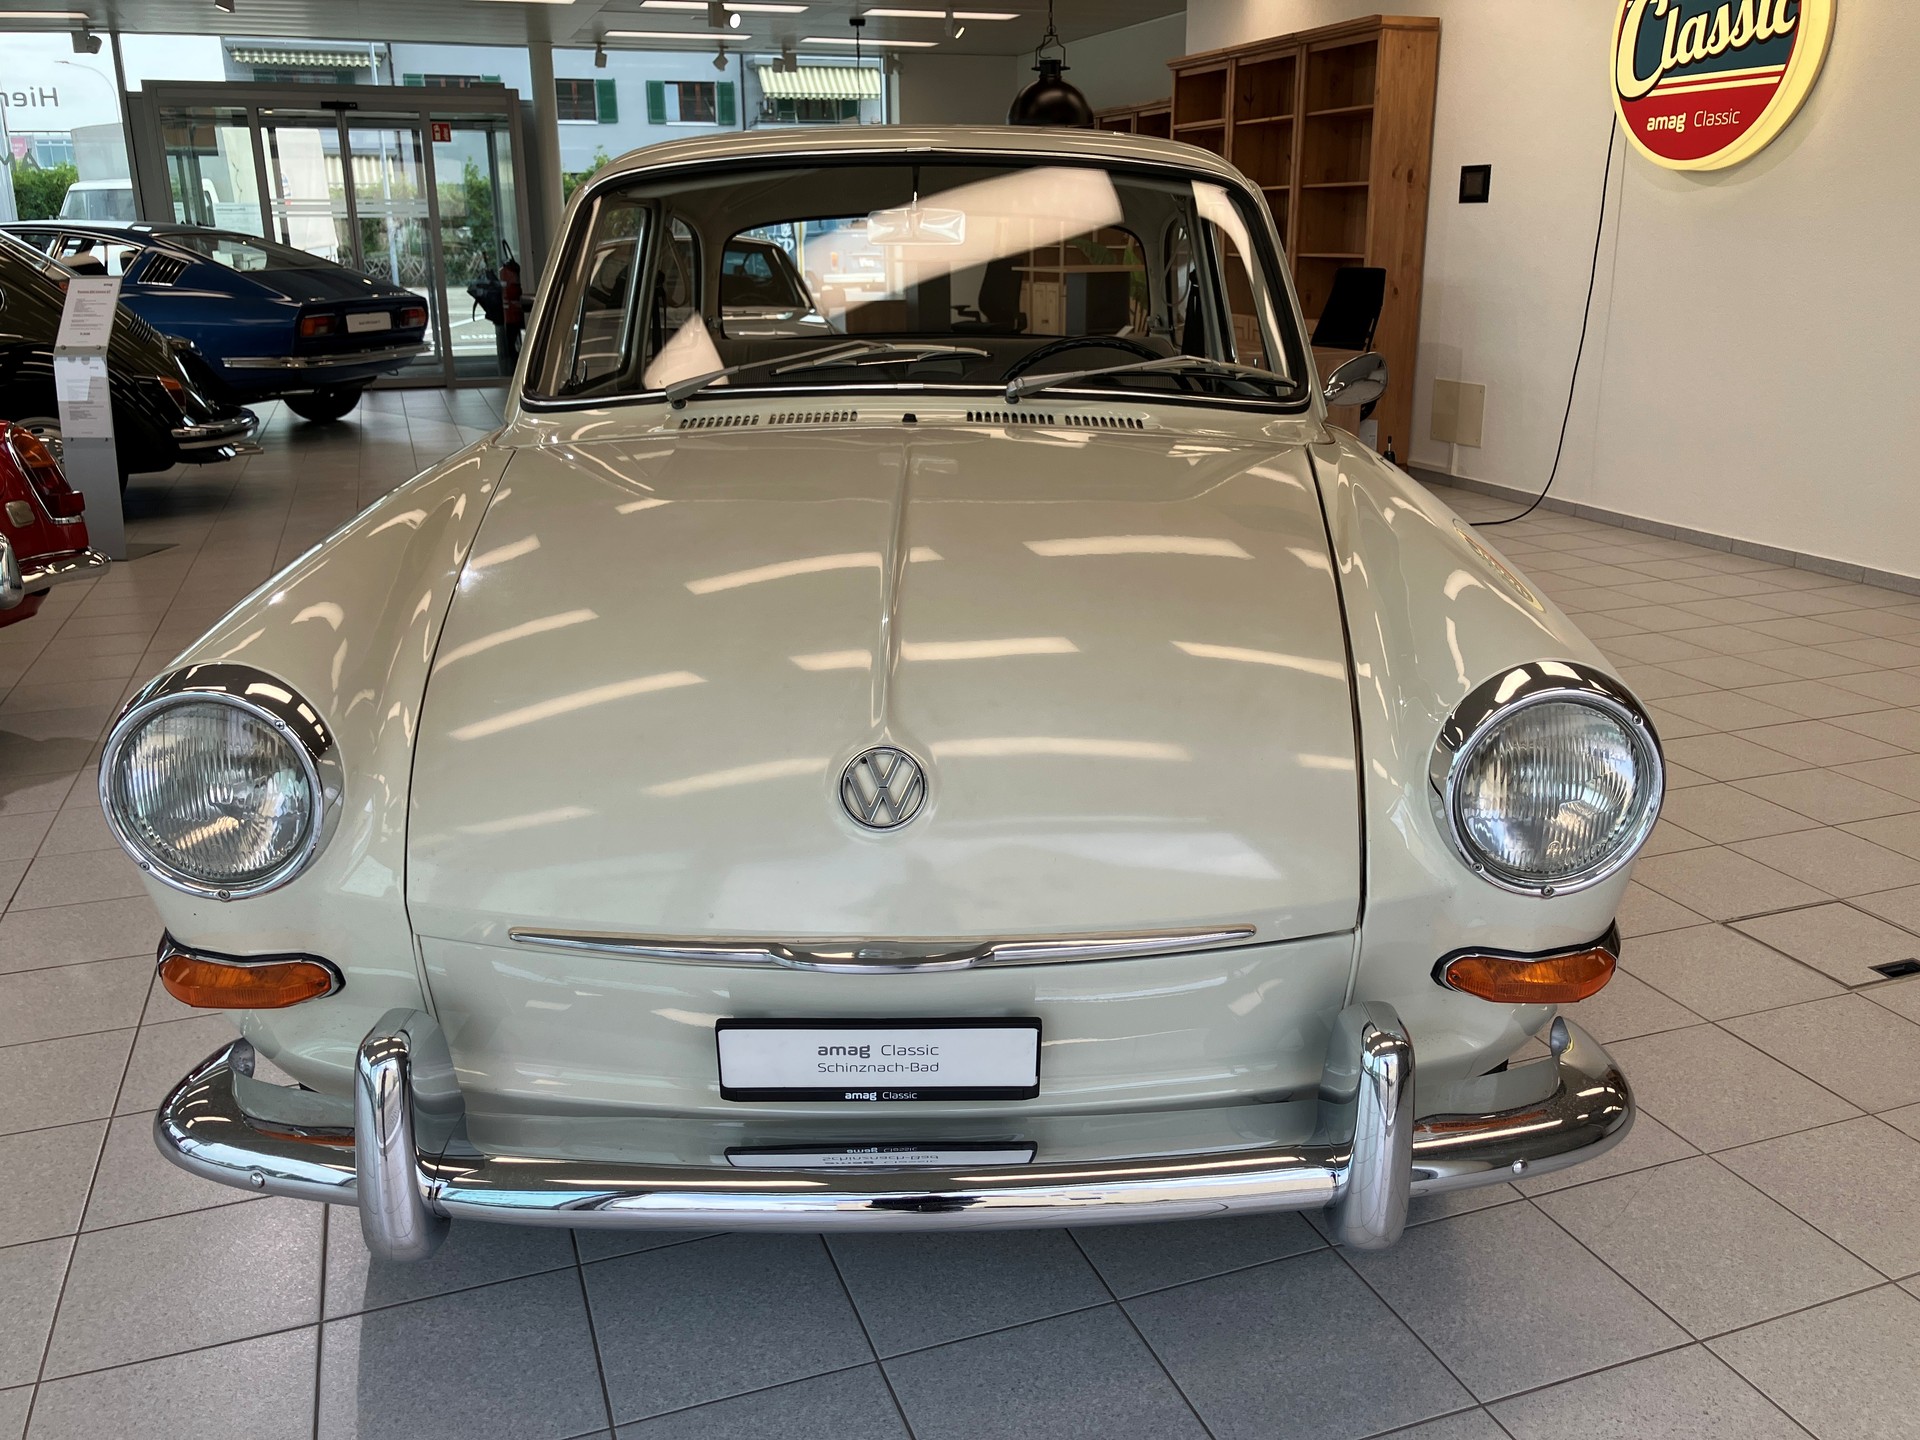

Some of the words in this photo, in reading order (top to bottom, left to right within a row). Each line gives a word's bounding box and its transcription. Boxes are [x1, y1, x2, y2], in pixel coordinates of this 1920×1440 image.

[1617, 0, 1799, 99] Classic
[1646, 112, 1687, 133] amag
[1693, 108, 1741, 127] Classic
[817, 1044, 871, 1059] amag
[880, 1044, 940, 1057] Classic
[817, 1062, 940, 1074] Schinznach-Bad
[844, 1091, 877, 1101] amag
[882, 1091, 918, 1100] Classic
